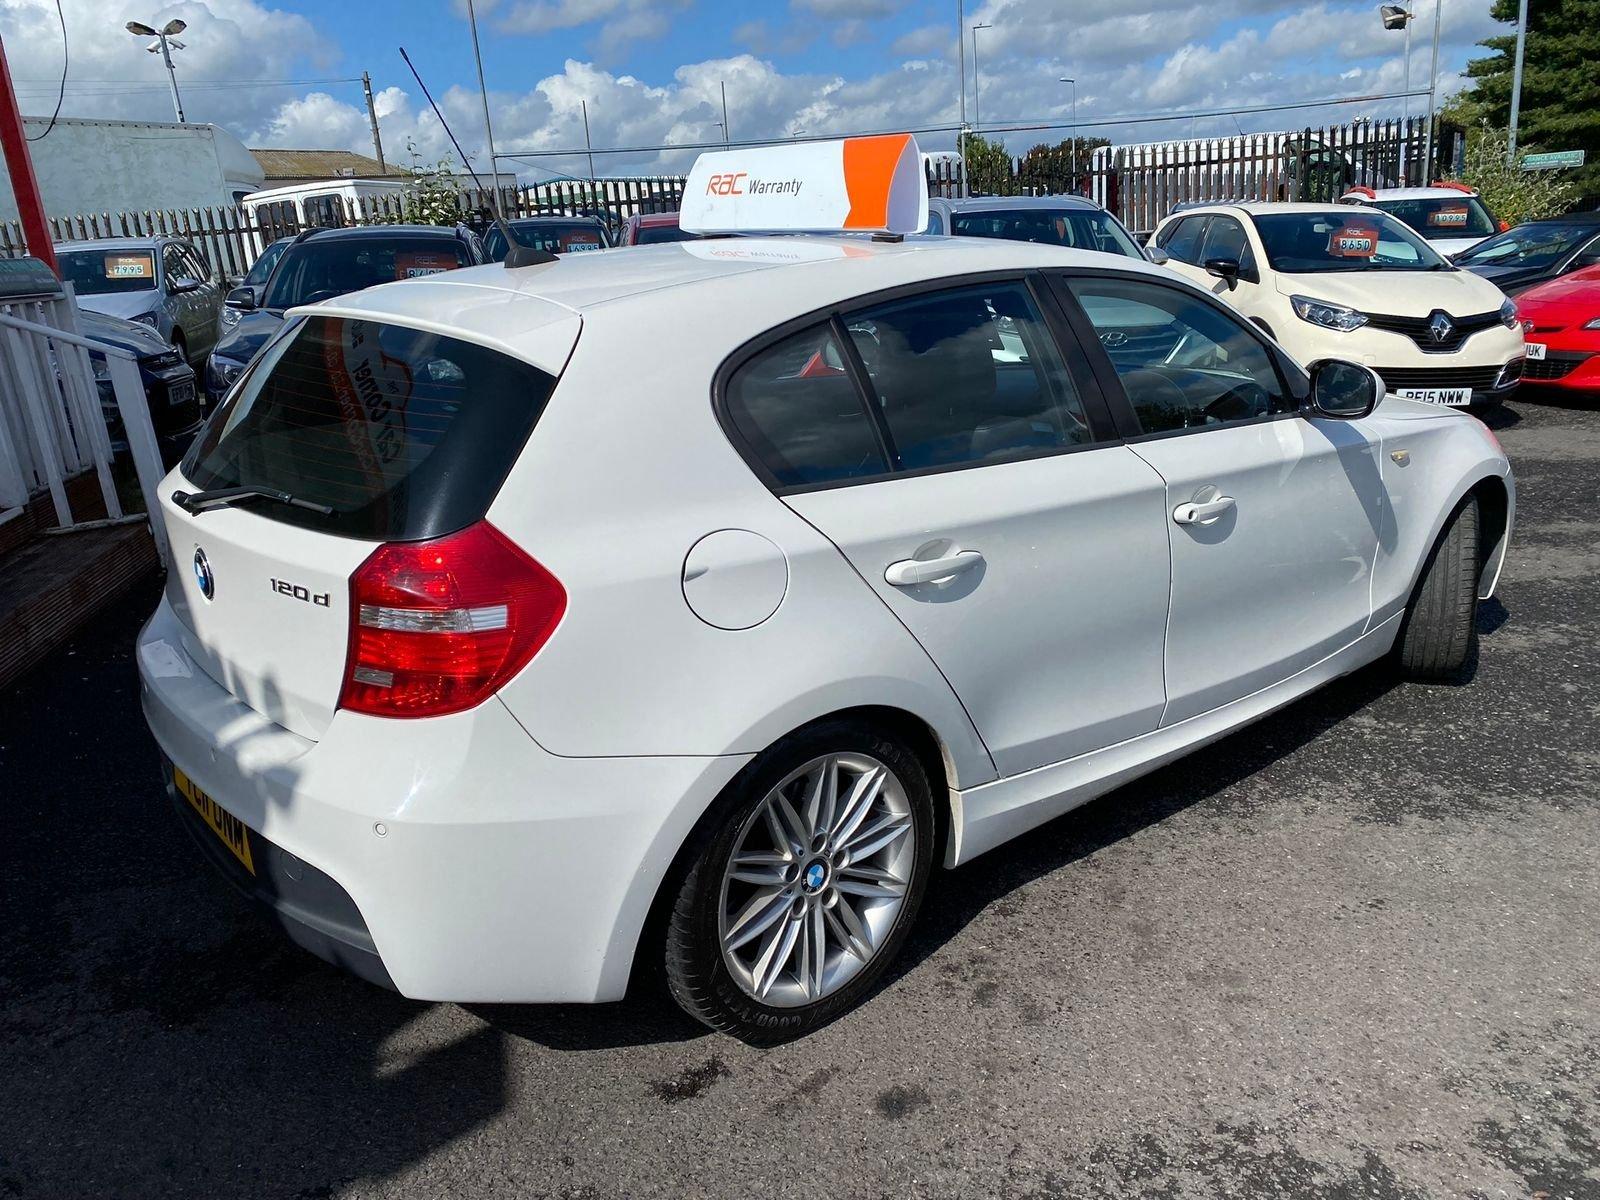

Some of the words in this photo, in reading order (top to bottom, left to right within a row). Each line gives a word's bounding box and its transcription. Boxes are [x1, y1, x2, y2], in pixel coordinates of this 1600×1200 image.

[748, 178, 803, 197] Warranty
[1436, 214, 1466, 222] 10995
[114, 265, 144, 275] 7995
[1438, 390, 1464, 403] NWW
[270, 578, 311, 603] 120
[313, 593, 331, 608] d
